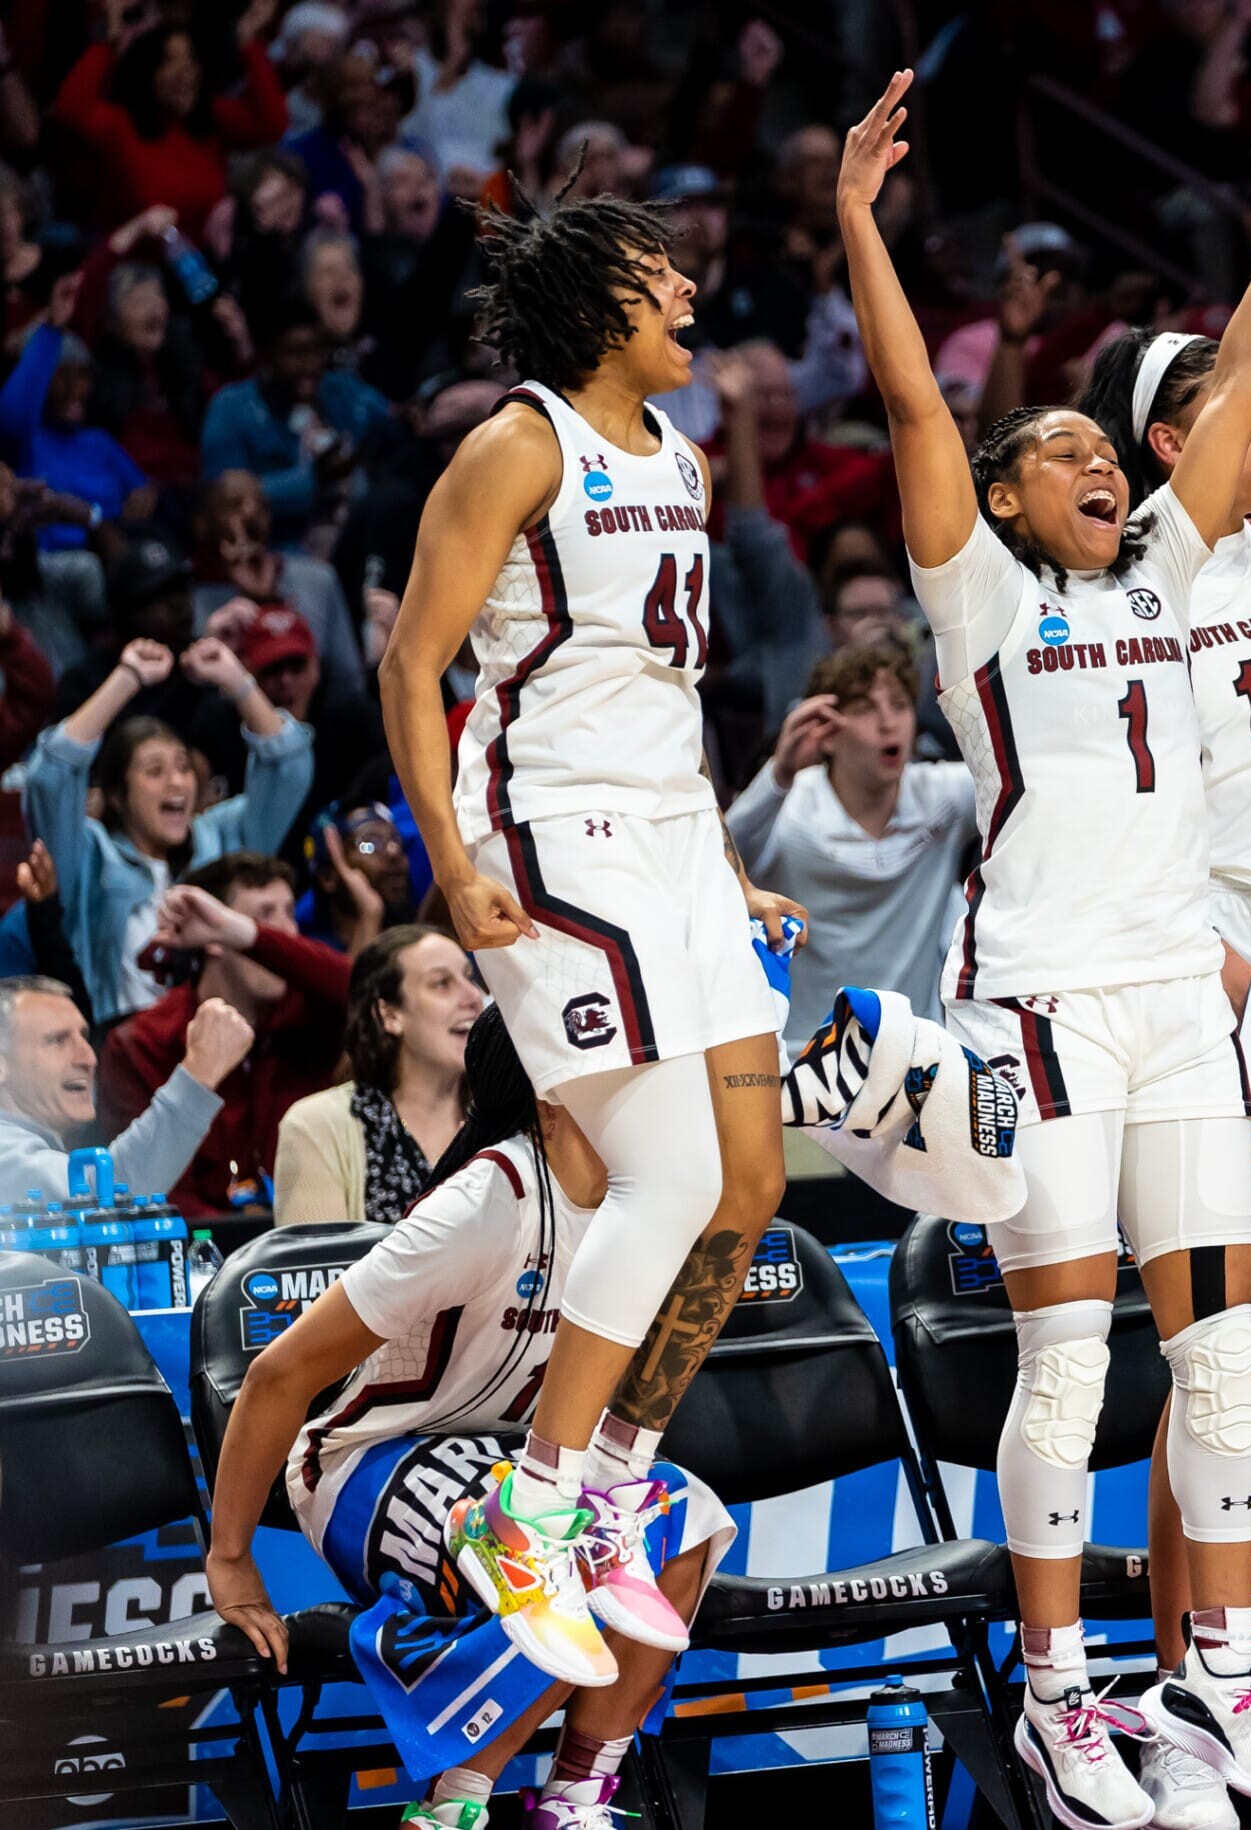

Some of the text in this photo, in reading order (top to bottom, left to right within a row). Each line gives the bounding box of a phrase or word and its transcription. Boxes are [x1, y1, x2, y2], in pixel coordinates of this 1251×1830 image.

[584, 504, 654, 537] SOUTH
[641, 552, 709, 670] 41
[1044, 629, 1069, 639] NCAA
[1026, 643, 1108, 675] SOUTH
[1117, 679, 1156, 794] 1
[976, 1073, 998, 1158] MADNESS
[766, 1570, 949, 1611] GAMECOCKS
[29, 1637, 218, 1678] GAMECOCKS
